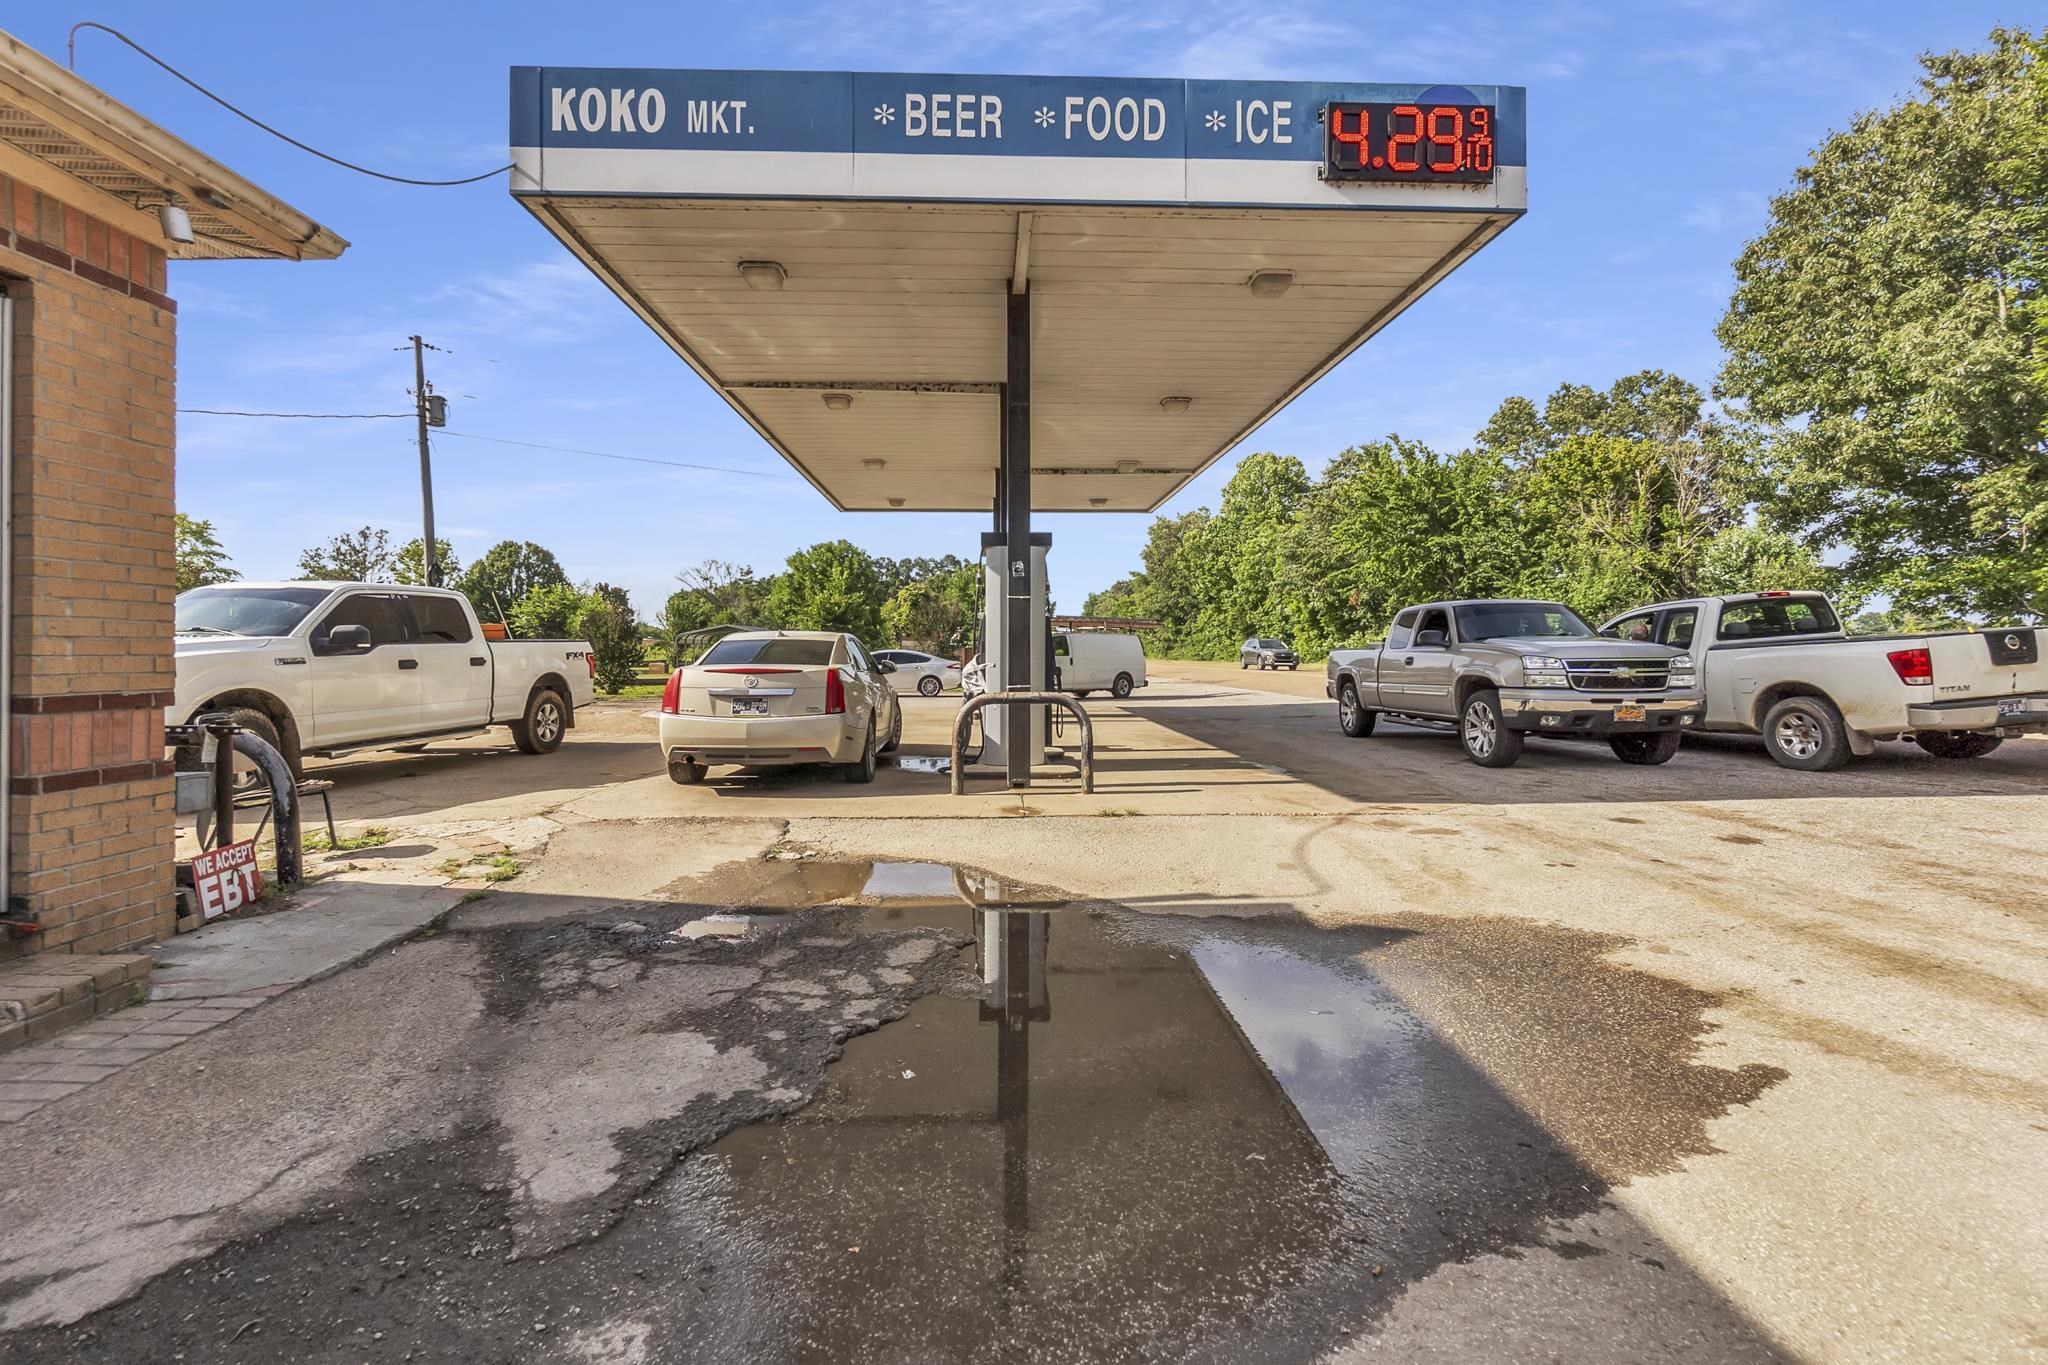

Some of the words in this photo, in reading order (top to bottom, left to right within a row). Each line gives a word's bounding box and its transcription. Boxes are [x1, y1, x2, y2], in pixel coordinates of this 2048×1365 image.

[550, 86, 667, 133] KOKO
[687, 99, 755, 135] MKT.
[905, 93, 1003, 139] BEER
[1064, 95, 1166, 142] FOOD
[1235, 99, 1293, 145] ICE
[1332, 105, 1463, 173] 4.29
[565, 651, 585, 661] FX4
[195, 856, 214, 876] WE
[216, 843, 253, 870] ACCEPT
[199, 861, 256, 919] EBT
